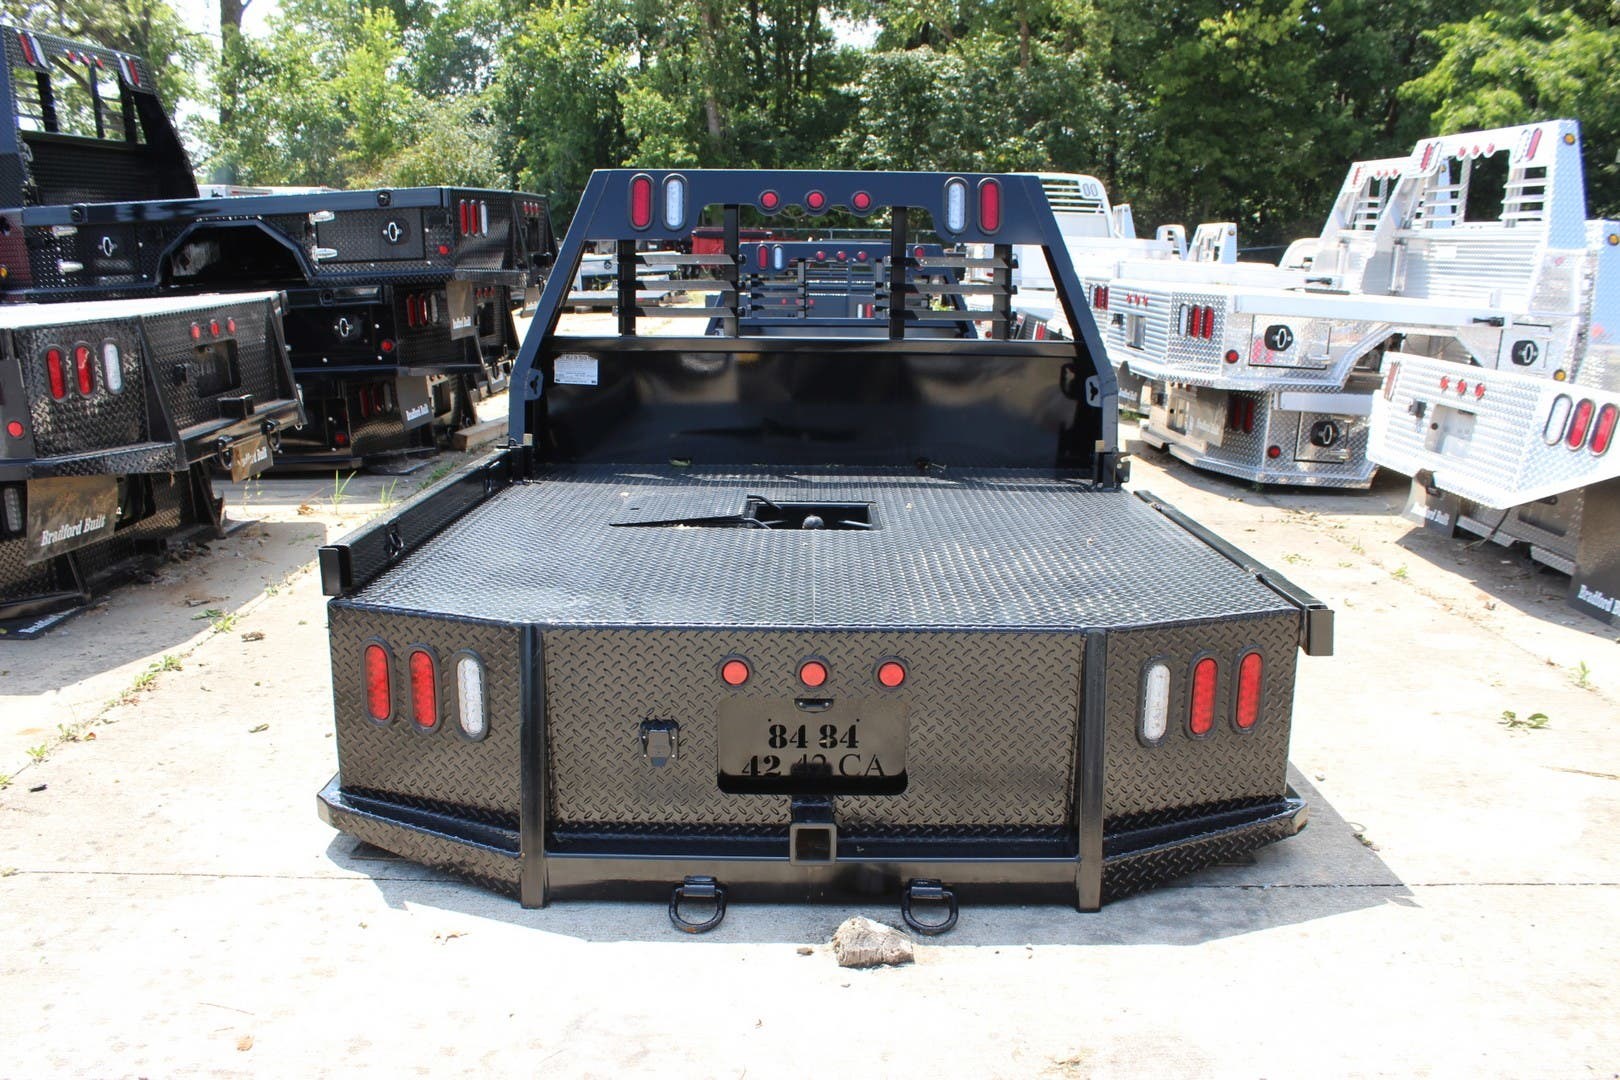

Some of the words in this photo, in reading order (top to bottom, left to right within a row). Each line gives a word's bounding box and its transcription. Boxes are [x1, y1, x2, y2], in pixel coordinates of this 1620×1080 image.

[41, 520, 82, 546] Bradford
[83, 513, 106, 533] Built
[768, 724, 809, 749] 84
[742, 755, 782, 777] 42
[838, 753, 885, 777] CA
